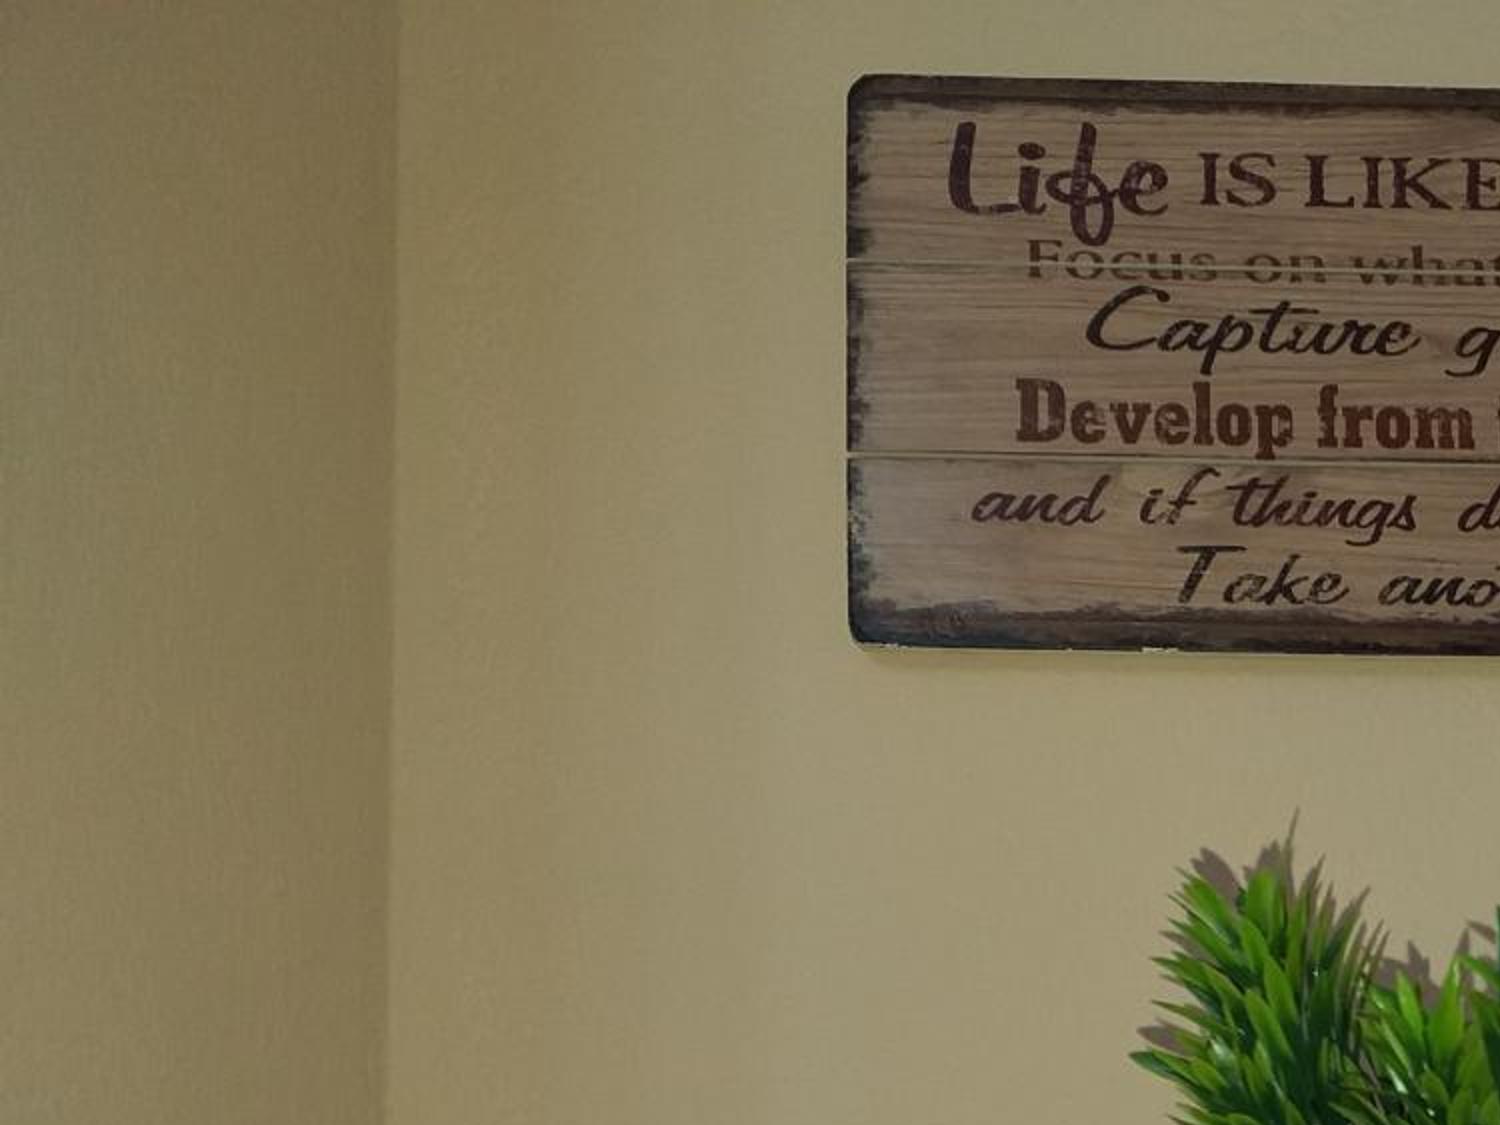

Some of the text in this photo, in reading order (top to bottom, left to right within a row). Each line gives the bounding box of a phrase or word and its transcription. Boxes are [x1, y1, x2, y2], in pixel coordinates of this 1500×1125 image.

[948, 122, 1169, 246] Life
[1199, 152, 1278, 208] IS
[1027, 239, 1217, 283] Focus
[1244, 252, 1327, 284] on
[1086, 285, 1421, 375] Capture
[1015, 377, 1294, 460] Develop
[1316, 384, 1476, 450] from
[970, 474, 1111, 527] and
[1139, 467, 1223, 526] if
[1225, 475, 1417, 546] things
[1176, 544, 1350, 606] Take
